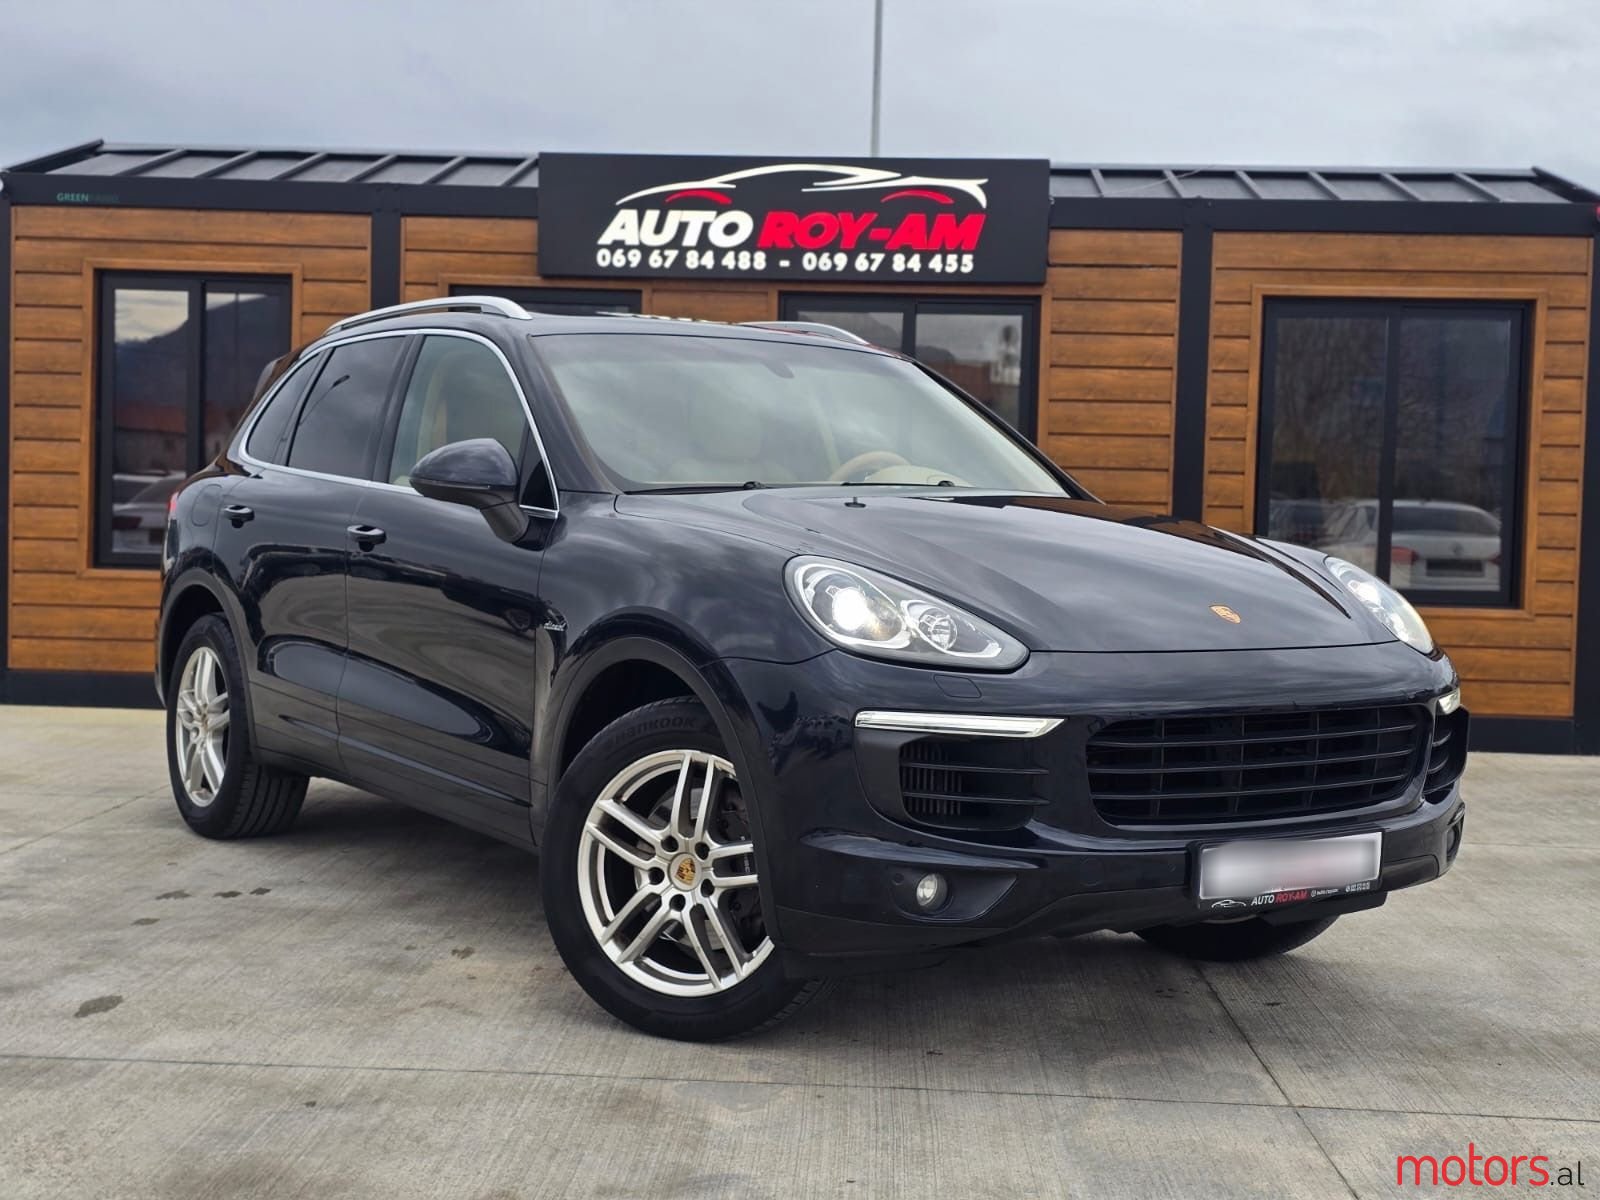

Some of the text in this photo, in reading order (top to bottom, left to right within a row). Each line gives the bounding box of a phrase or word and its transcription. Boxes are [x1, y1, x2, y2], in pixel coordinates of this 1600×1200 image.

[597, 209, 986, 250] AUTO ROY-AM
[596, 248, 642, 268] 069
[648, 250, 679, 269] 67
[685, 250, 715, 270] 84
[721, 251, 767, 271] 488
[802, 252, 848, 272] 069
[854, 253, 886, 273] 67
[892, 253, 922, 273] 84
[928, 254, 974, 274] 455
[1250, 894, 1275, 906] AUTO
